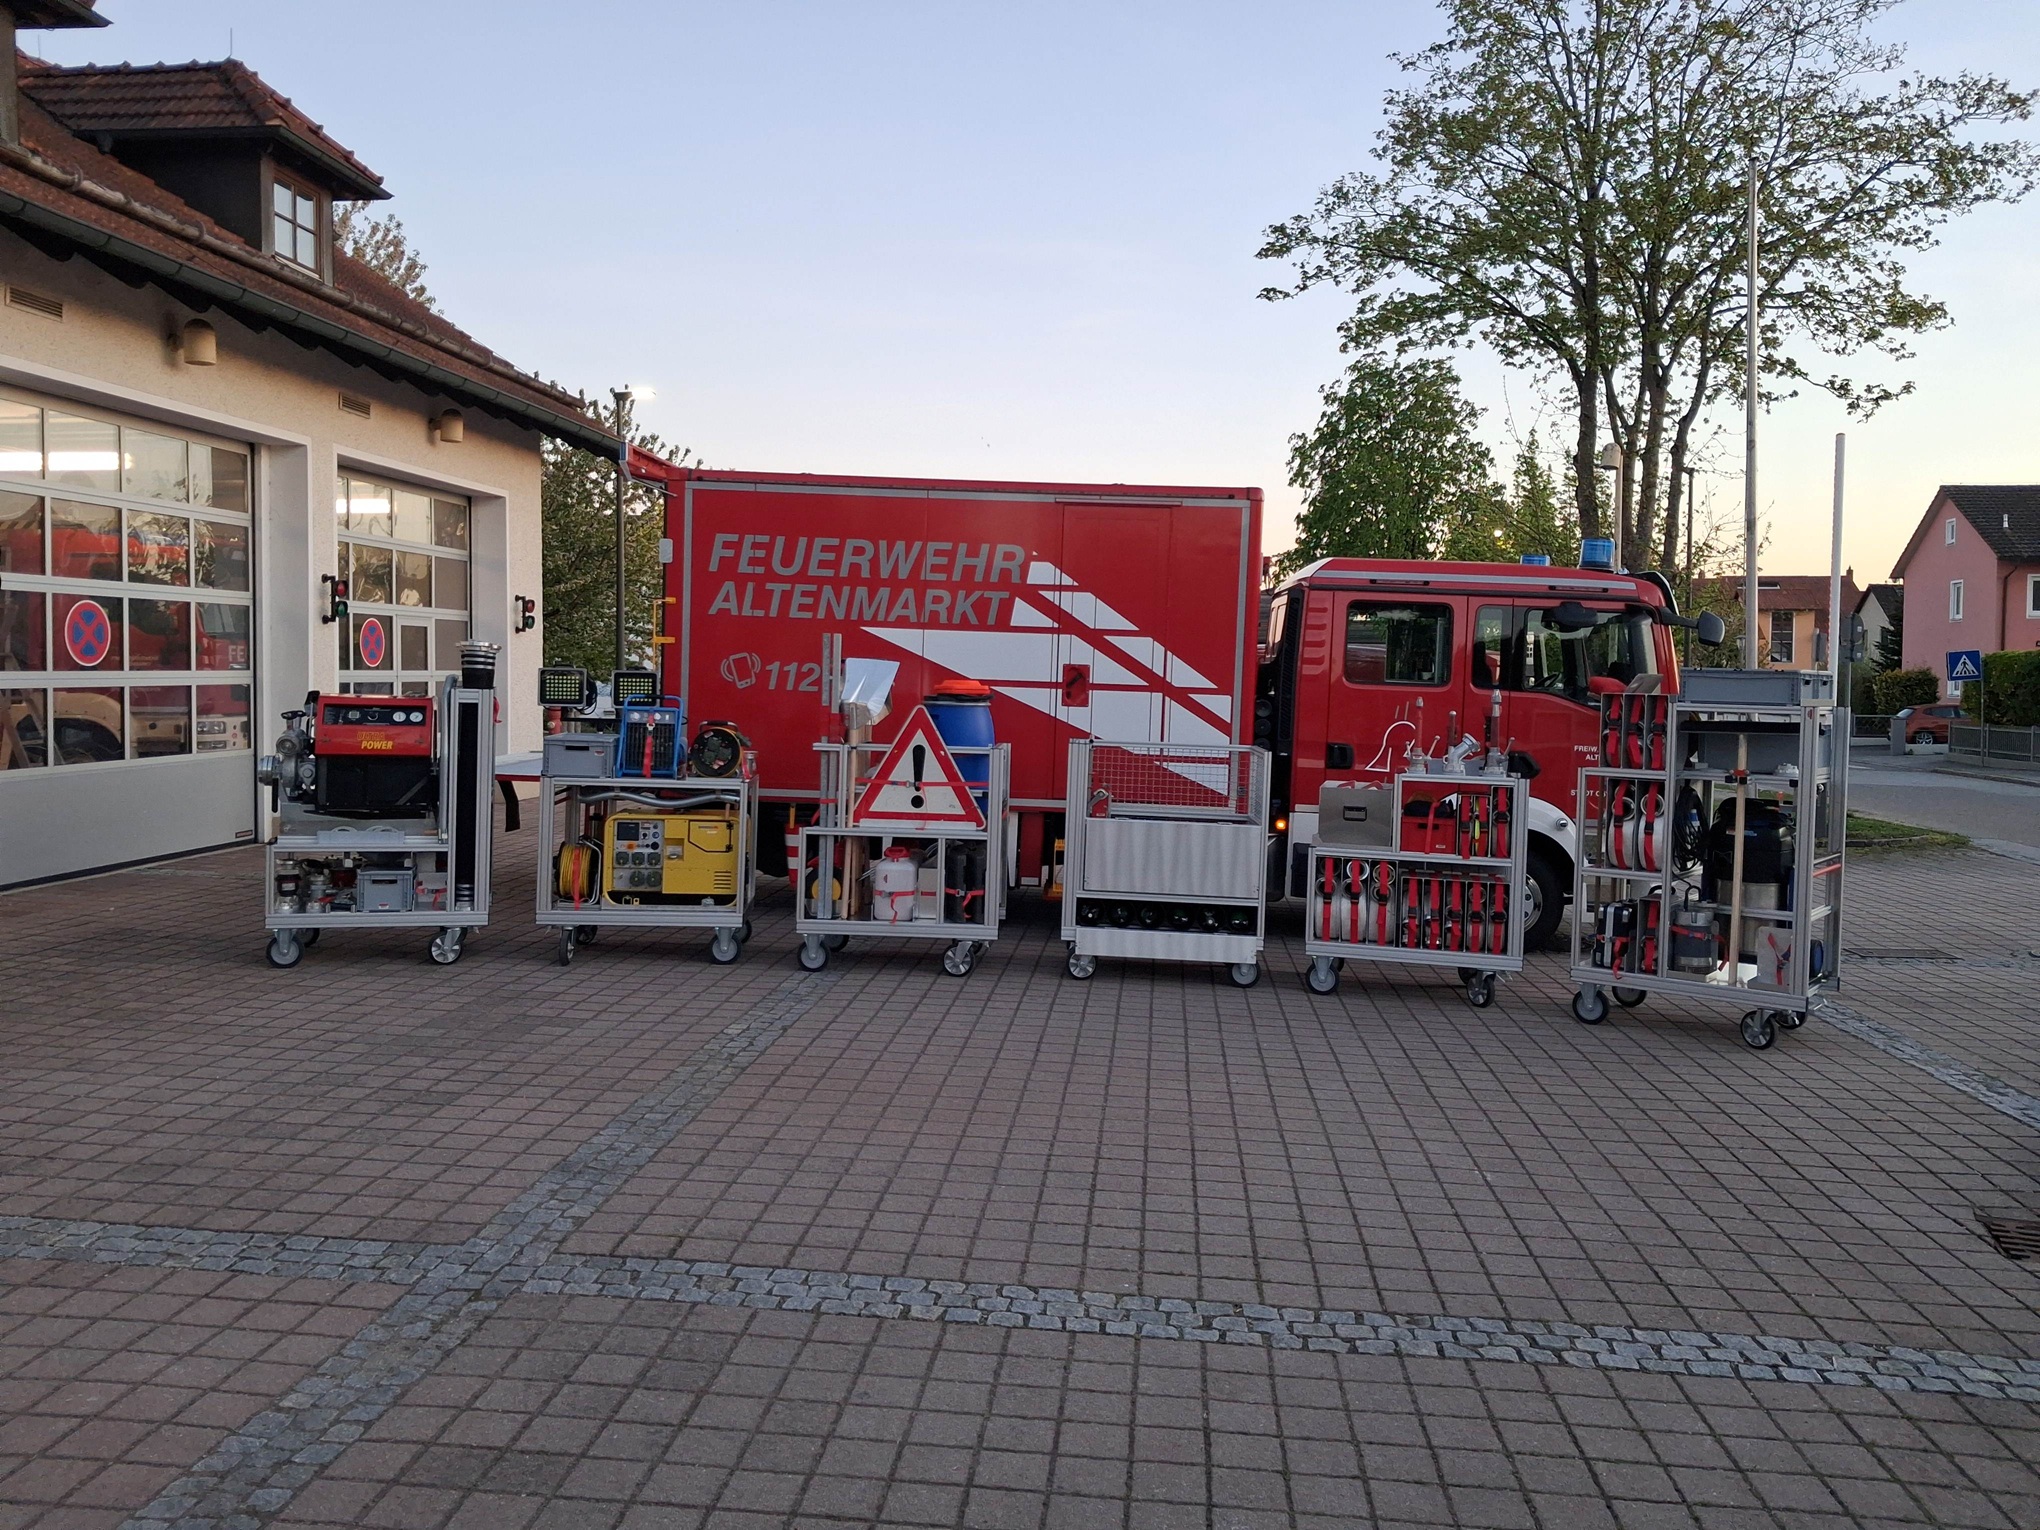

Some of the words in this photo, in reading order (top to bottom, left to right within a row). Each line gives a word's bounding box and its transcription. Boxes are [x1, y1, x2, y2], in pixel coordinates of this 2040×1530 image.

[707, 533, 1026, 583] FEUERWEHR
[707, 580, 1011, 626] ALTENMARKT
[764, 661, 822, 692] 112
[361, 740, 394, 750] POWER
